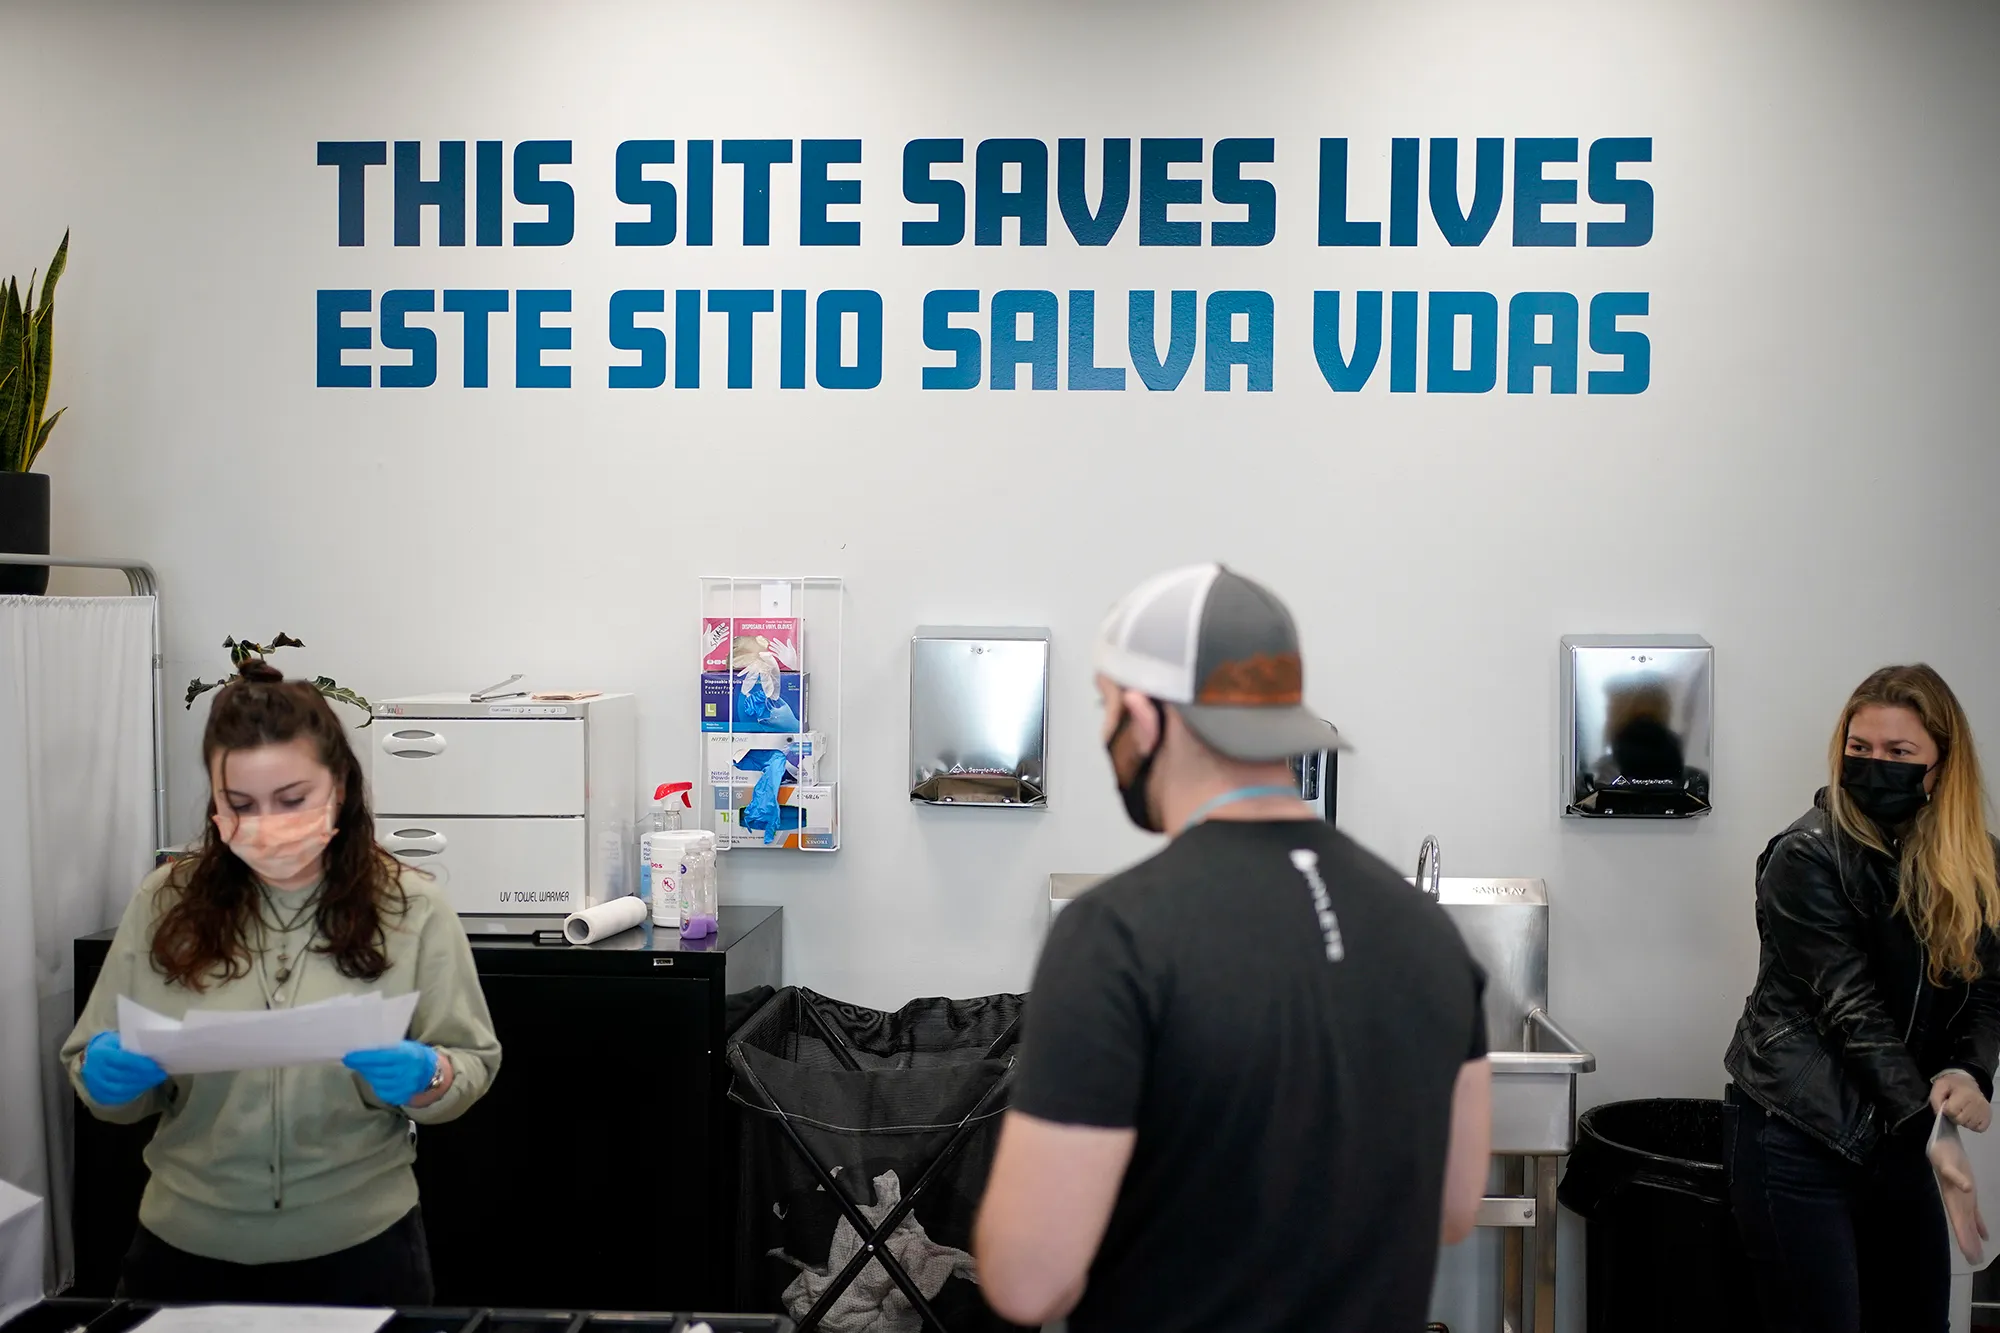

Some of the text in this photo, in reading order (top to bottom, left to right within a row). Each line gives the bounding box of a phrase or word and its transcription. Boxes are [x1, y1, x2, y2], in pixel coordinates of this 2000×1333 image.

[317, 137, 1654, 247] THIS SITE SAVES LIVES
[317, 290, 1652, 394] ESTE SITIO SALVA VIDAS
[707, 704, 714, 713] L
[499, 891, 570, 902] UV TOWEL WARMER
